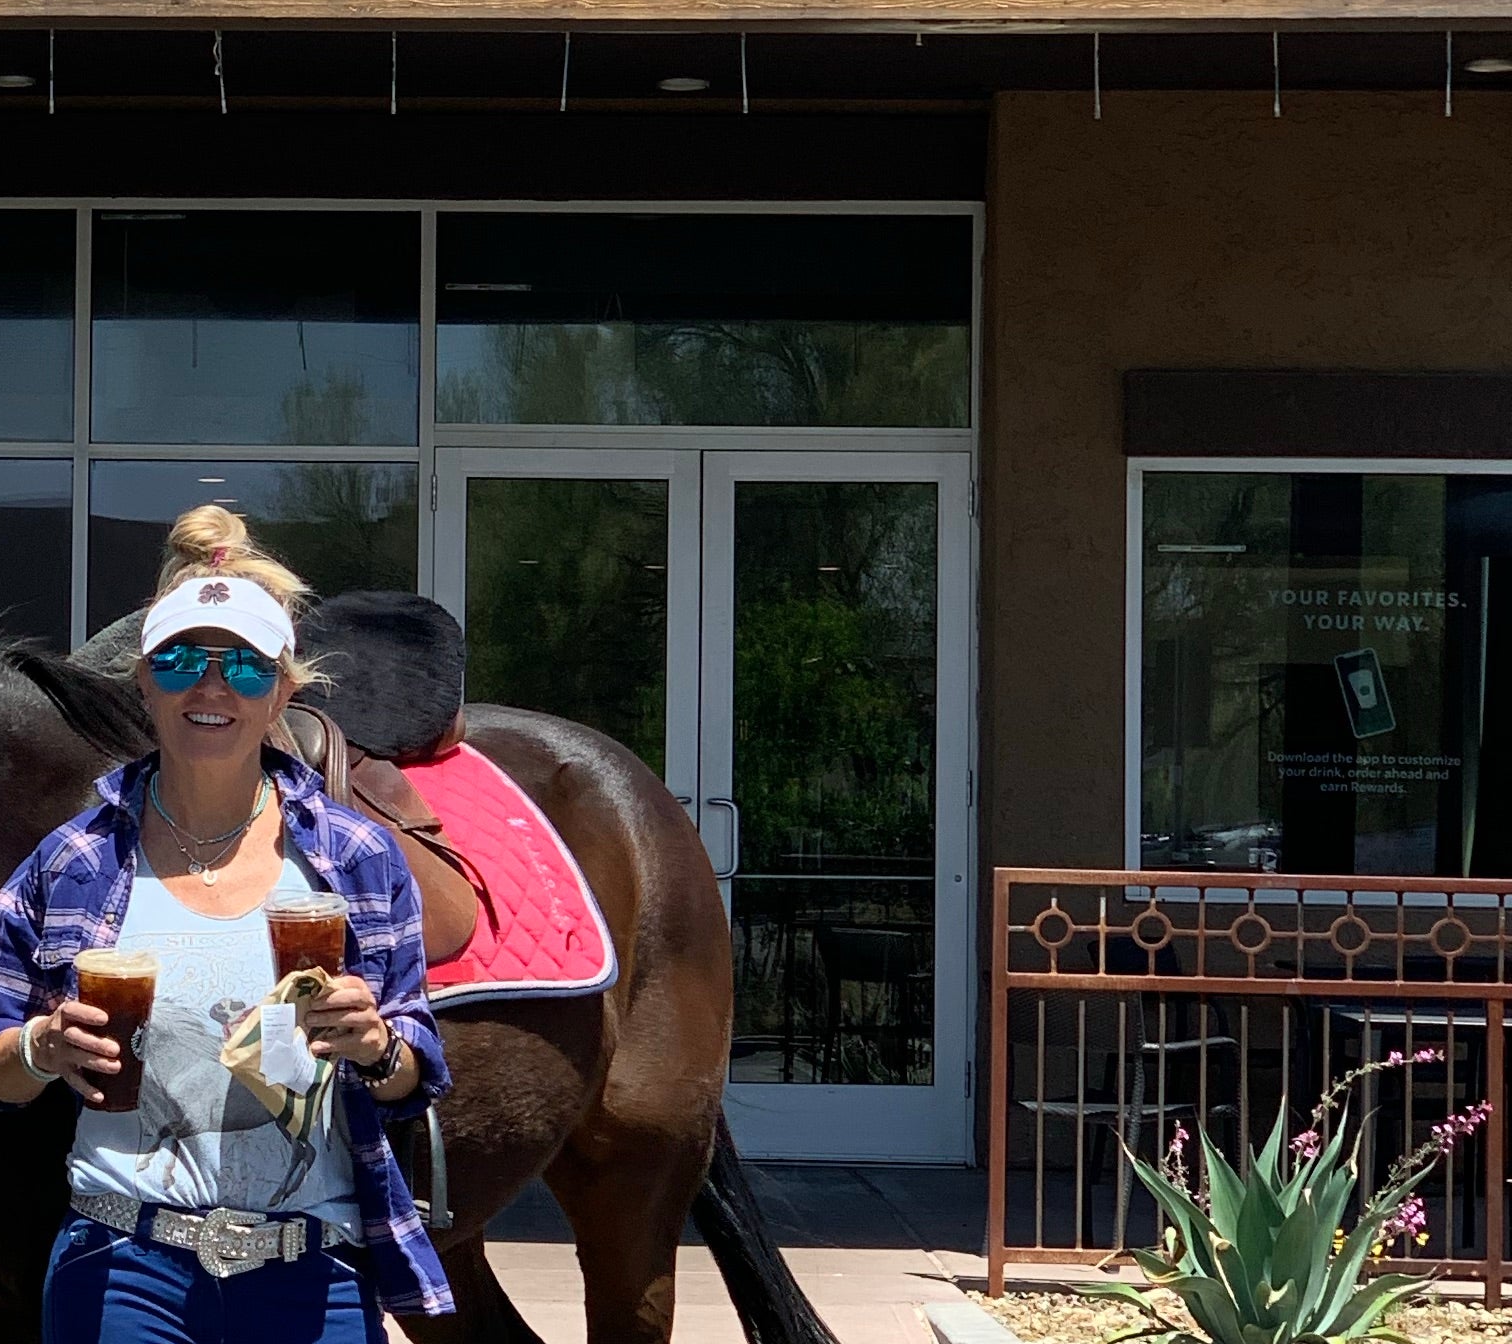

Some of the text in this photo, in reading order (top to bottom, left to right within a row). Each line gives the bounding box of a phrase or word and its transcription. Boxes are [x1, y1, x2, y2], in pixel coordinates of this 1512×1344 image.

[1268, 589, 1467, 608] YOUR FAVORITES.
[1304, 614, 1430, 632] YOUR WAY.
[1267, 750, 1462, 768] Download the app to customize
[1278, 767, 1306, 780] your
[1347, 766, 1382, 779] order
[1384, 767, 1423, 780] ahead
[1425, 769, 1450, 781] and
[1319, 782, 1348, 793] earn
